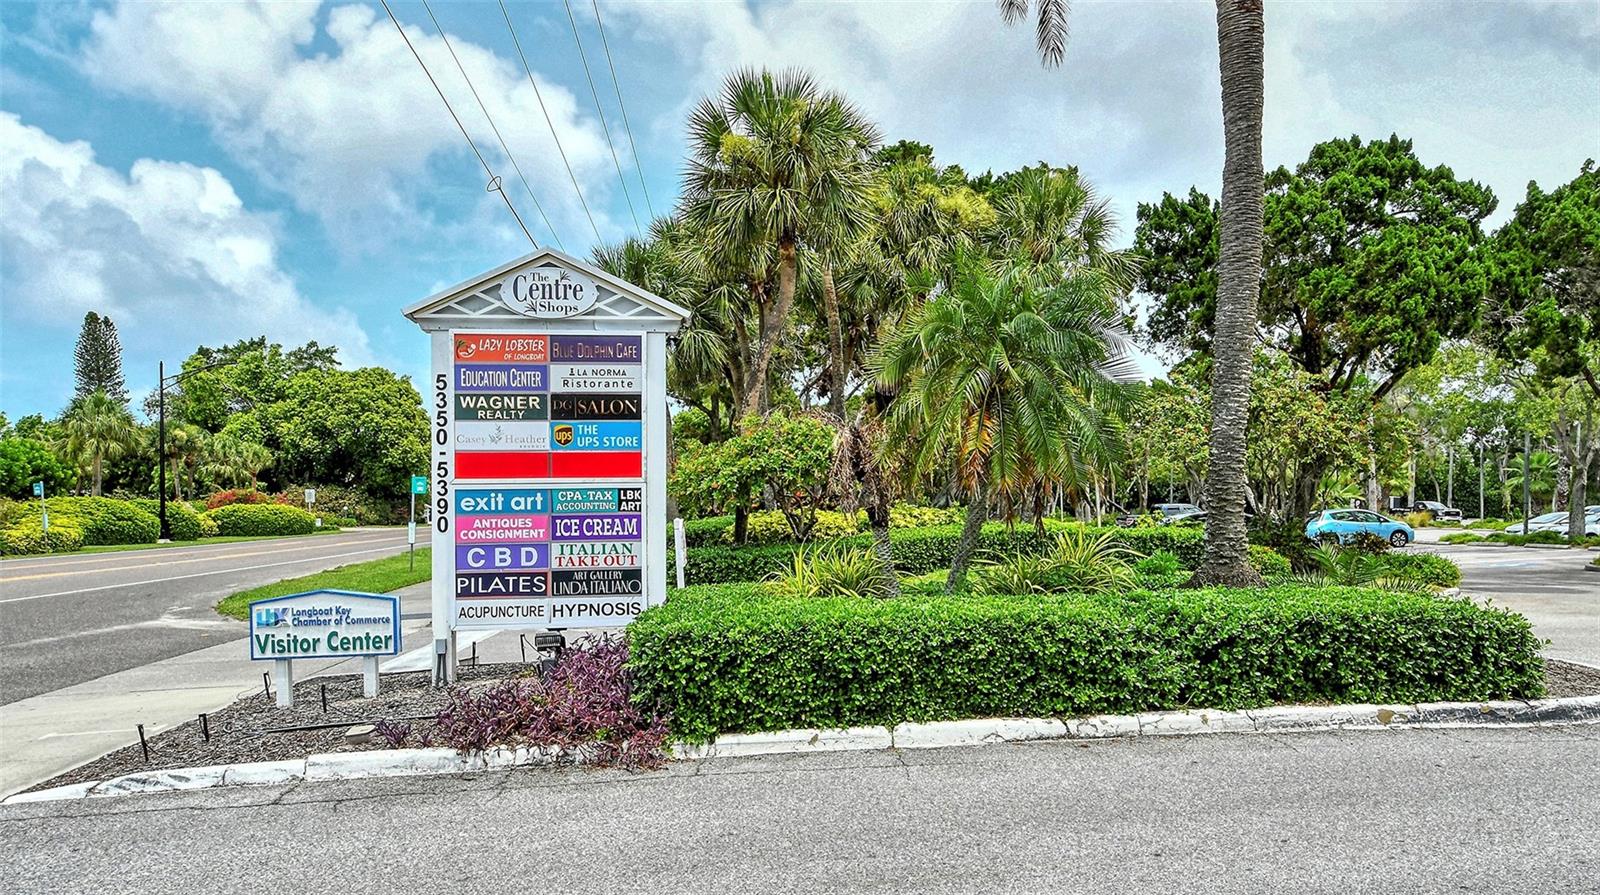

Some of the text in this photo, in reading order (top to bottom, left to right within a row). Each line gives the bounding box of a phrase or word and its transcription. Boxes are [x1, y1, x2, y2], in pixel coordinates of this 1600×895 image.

[530, 272, 549, 282] The
[512, 274, 584, 303] Centre
[539, 301, 579, 316] Shops
[479, 338, 545, 352] LAZY LOBSTER
[514, 353, 544, 361] LONGBOAT
[577, 368, 627, 377] LA NORMA
[562, 378, 633, 389] Ristorante
[460, 396, 541, 410] WAGNER
[553, 399, 638, 415] DG SALON
[477, 410, 525, 420] REALTY
[577, 424, 598, 435] THE
[456, 434, 546, 446] Casey Heather
[556, 431, 572, 444] ups
[577, 436, 639, 447] UPS STORE
[620, 490, 641, 500] LBK
[460, 493, 543, 511] exit art
[556, 501, 616, 511] ACCOUNTING
[620, 501, 641, 511] ART
[473, 518, 532, 528] ANTIQUES
[555, 518, 638, 537] ICE CREAM
[460, 529, 545, 540] CONSIGNMENT
[559, 543, 633, 555] ITALIAN
[555, 555, 637, 567] TAKE OUT
[572, 571, 623, 580] ART GALLERY
[457, 576, 546, 594] PILATES
[553, 579, 641, 595] LINDA ITALIANO
[291, 606, 352, 618] Longboat Key
[458, 605, 545, 618] ACUPUNCTURE
[552, 602, 641, 618] HYPNOSIS
[292, 615, 391, 627] Chamber of Commerce
[255, 631, 393, 654] Visitor Center
